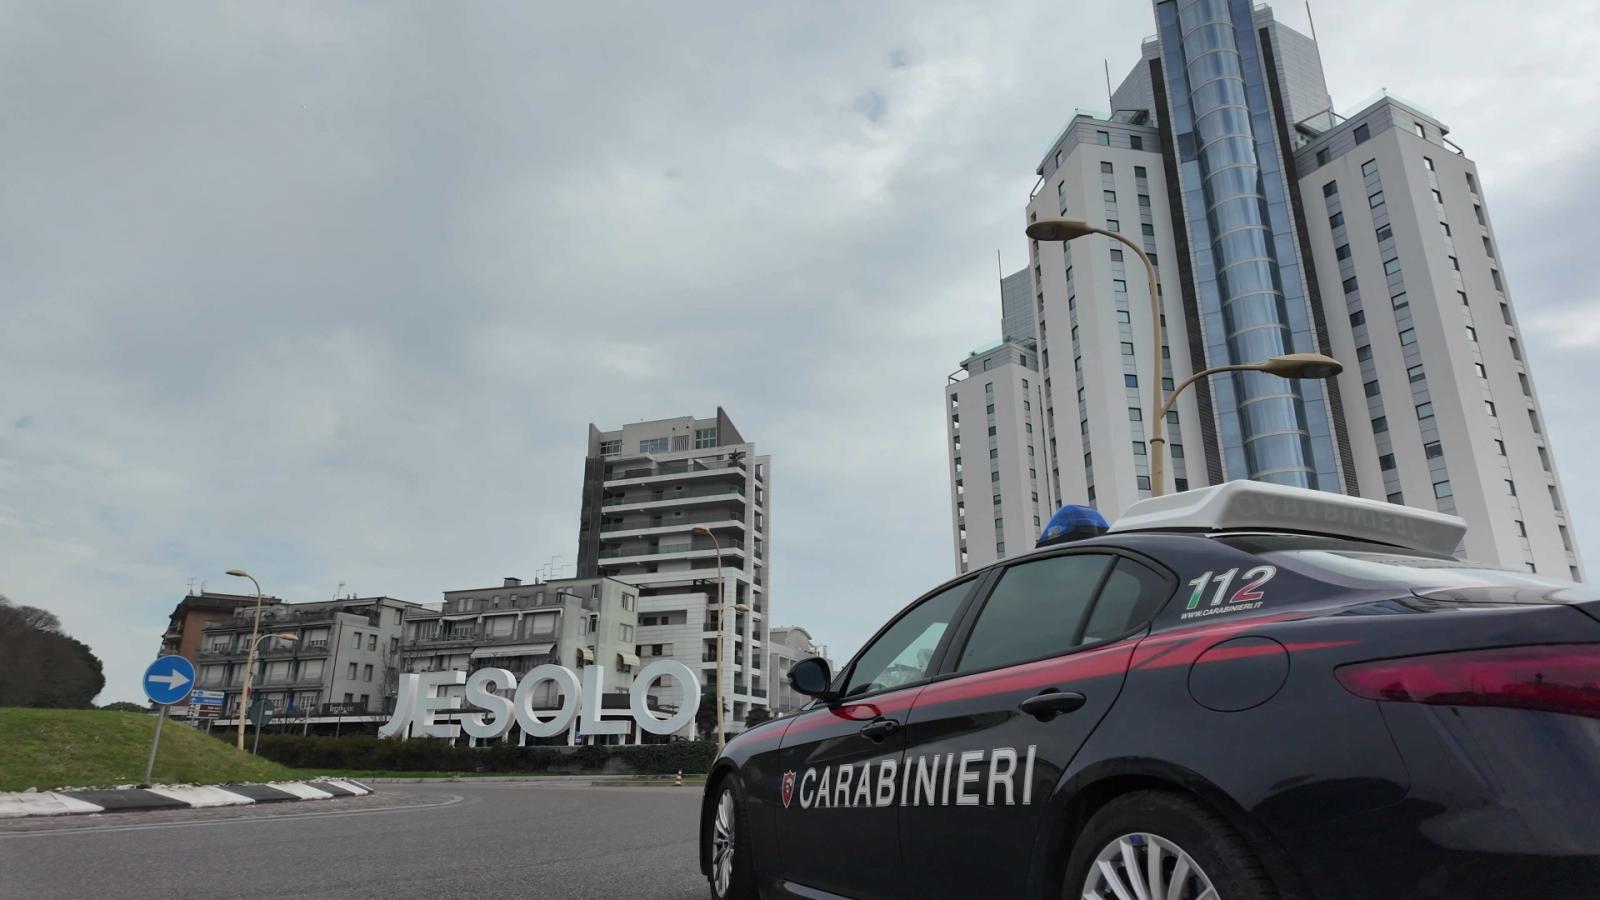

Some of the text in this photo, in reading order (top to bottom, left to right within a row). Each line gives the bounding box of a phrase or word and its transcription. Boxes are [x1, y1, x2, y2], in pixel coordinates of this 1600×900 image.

[1181, 601, 1263, 620] WWW.CARABINIERI.IT
[1187, 565, 1277, 610] 112
[378, 660, 700, 739] JESOLO
[799, 745, 1037, 809] CARABINIERI
